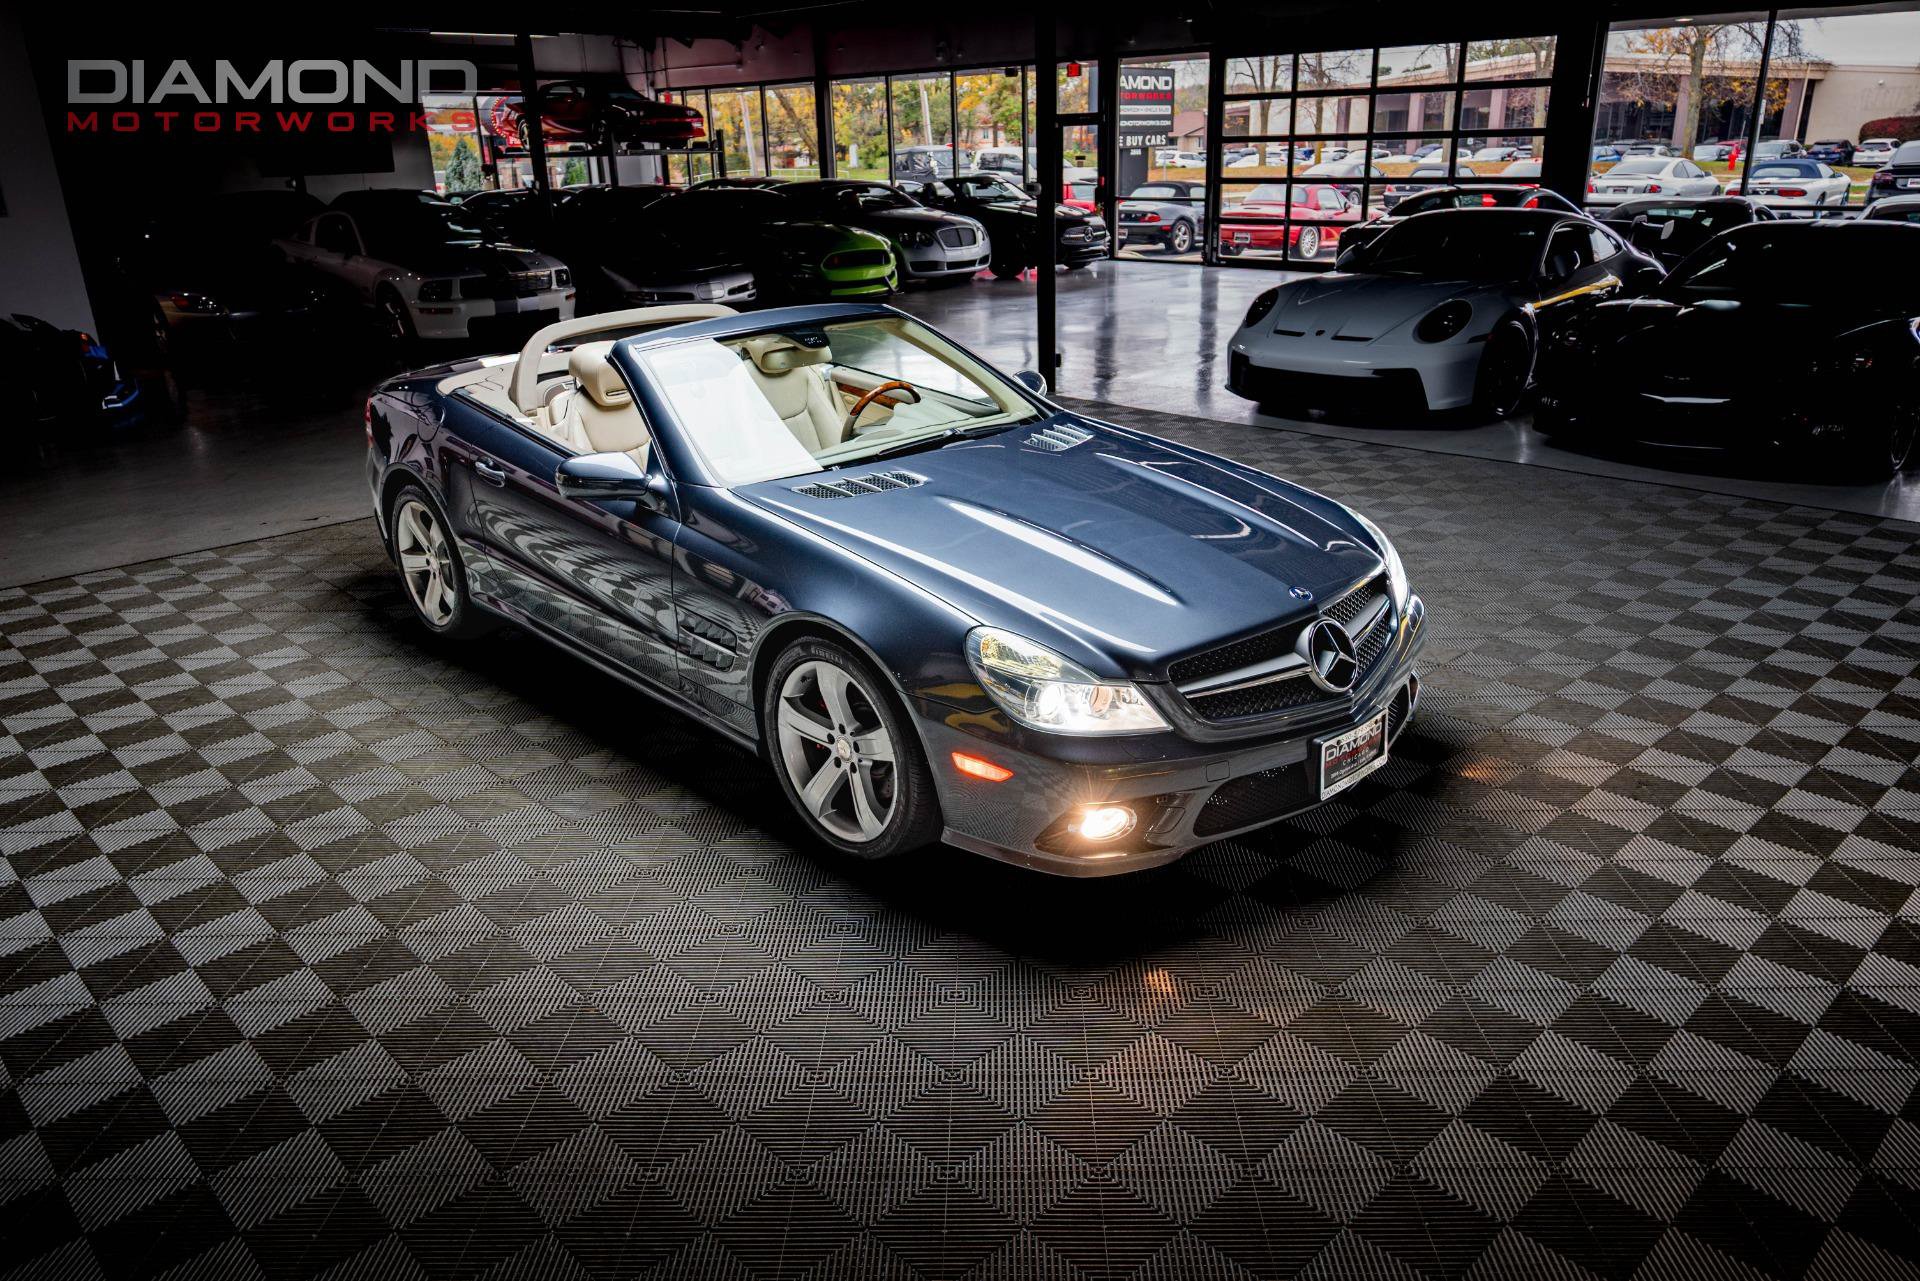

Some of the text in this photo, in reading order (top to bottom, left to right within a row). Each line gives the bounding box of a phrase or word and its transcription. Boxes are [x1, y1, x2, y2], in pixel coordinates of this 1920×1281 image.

[1126, 135, 1143, 147] BUY
[1145, 134, 1166, 146] CARS
[1326, 722, 1381, 761] DIAMOND
